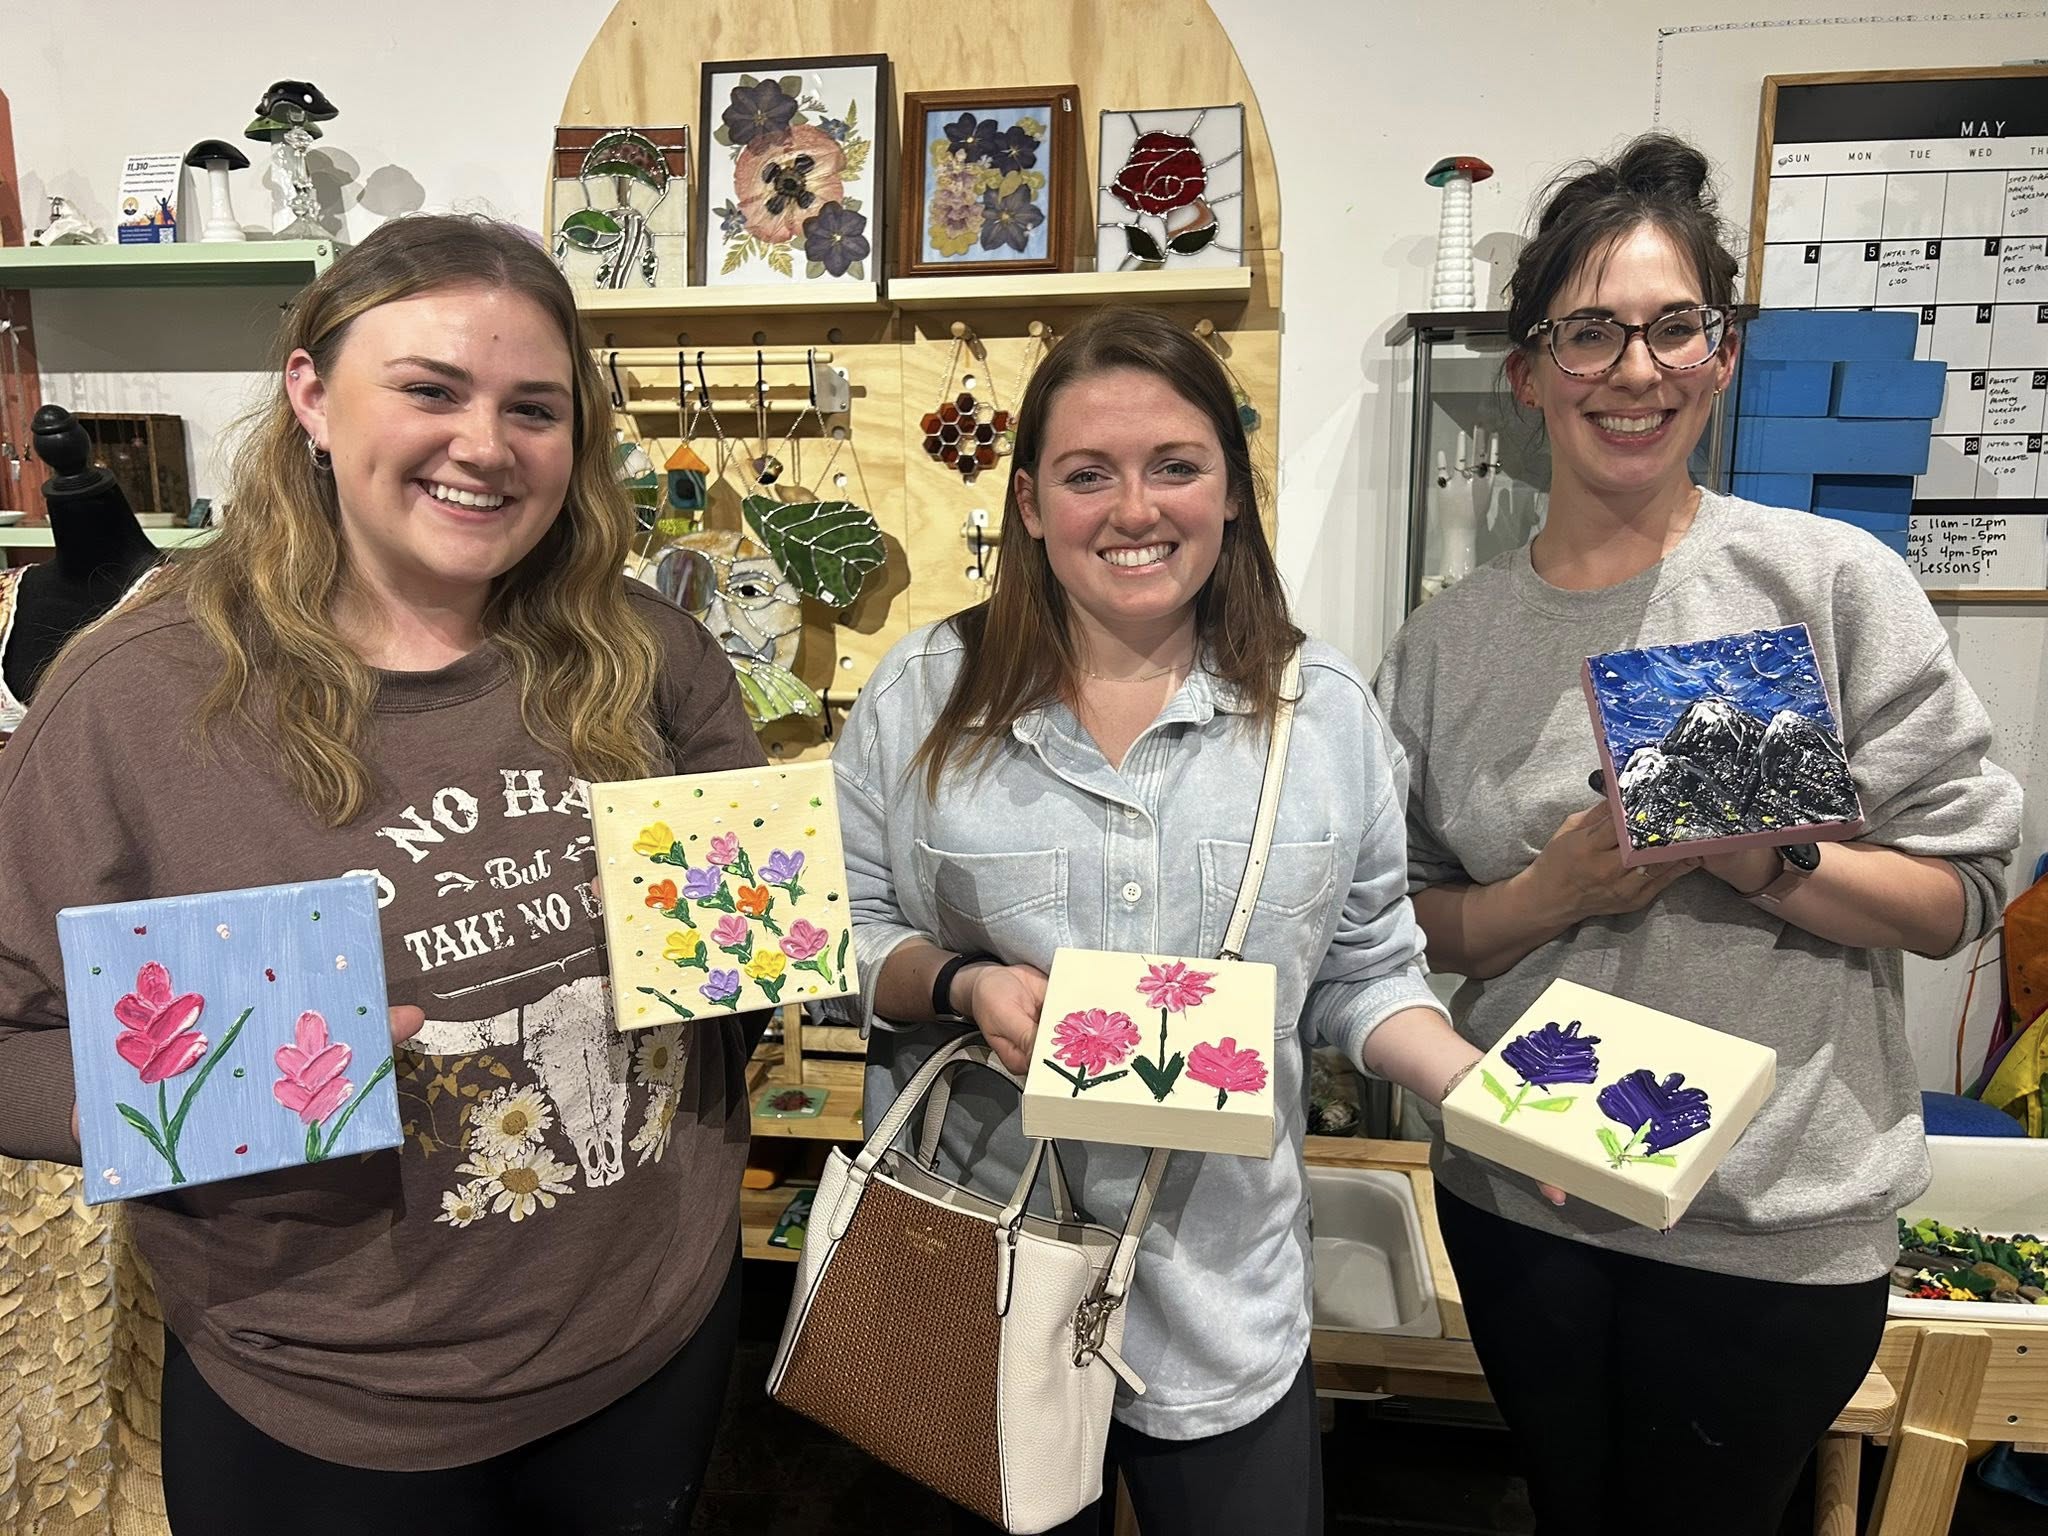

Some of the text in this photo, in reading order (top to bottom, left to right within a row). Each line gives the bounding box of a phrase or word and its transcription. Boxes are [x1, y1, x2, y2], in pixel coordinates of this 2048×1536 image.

[1960, 120, 2007, 138] MAY
[1787, 154, 1811, 163] SUN
[1848, 152, 1873, 161] MON
[1909, 150, 1932, 159] TUE
[1969, 148, 1993, 157] WED
[1868, 246, 1876, 257] 5
[1929, 244, 1937, 255] 6
[1989, 242, 1996, 252] 7
[1808, 249, 1816, 260] 4
[1883, 248, 1921, 259] INTRO TO
[1888, 278, 1908, 287] 6:00
[2007, 278, 2026, 286] 6:00
[1924, 310, 1934, 321] 13
[1979, 308, 1989, 319] 14
[1973, 375, 1983, 386] 21
[2034, 374, 2046, 386] 22
[1993, 418, 2016, 426] 6:00
[1966, 440, 1978, 451] 28
[1986, 440, 2010, 448] INTRO
[2029, 438, 2040, 449] 29
[1993, 467, 2016, 476] 6:00
[375, 768, 592, 864] NO HA
[484, 849, 551, 890] But
[403, 908, 515, 972] TAKE
[516, 892, 571, 940] NO
